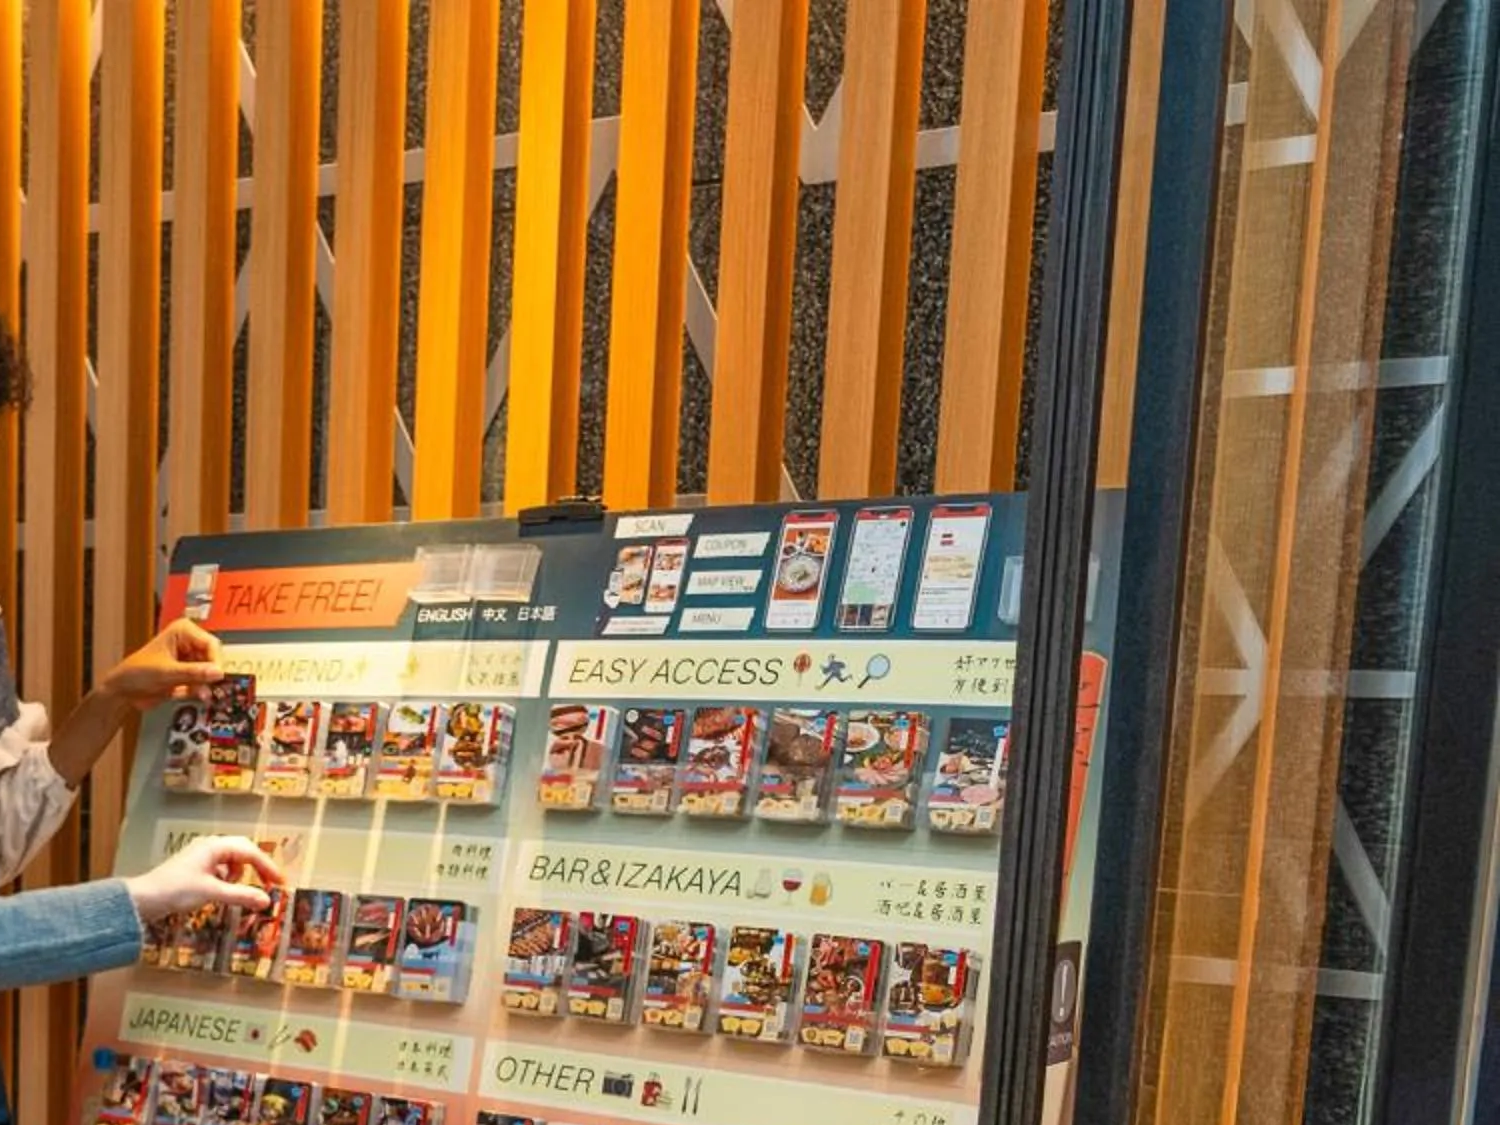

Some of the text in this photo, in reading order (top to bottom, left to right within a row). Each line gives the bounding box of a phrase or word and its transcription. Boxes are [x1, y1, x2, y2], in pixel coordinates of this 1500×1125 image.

[224, 578, 384, 616] TAKE FREE!
[417, 607, 473, 623] ENGLISH
[481, 607, 509, 622] 中文
[517, 604, 557, 622] 日本語
[221, 659, 343, 683] COMMEND
[569, 657, 784, 686] EASY ACCESS
[129, 1005, 241, 1044] JAPANESE
[495, 1056, 596, 1095] OTHER
